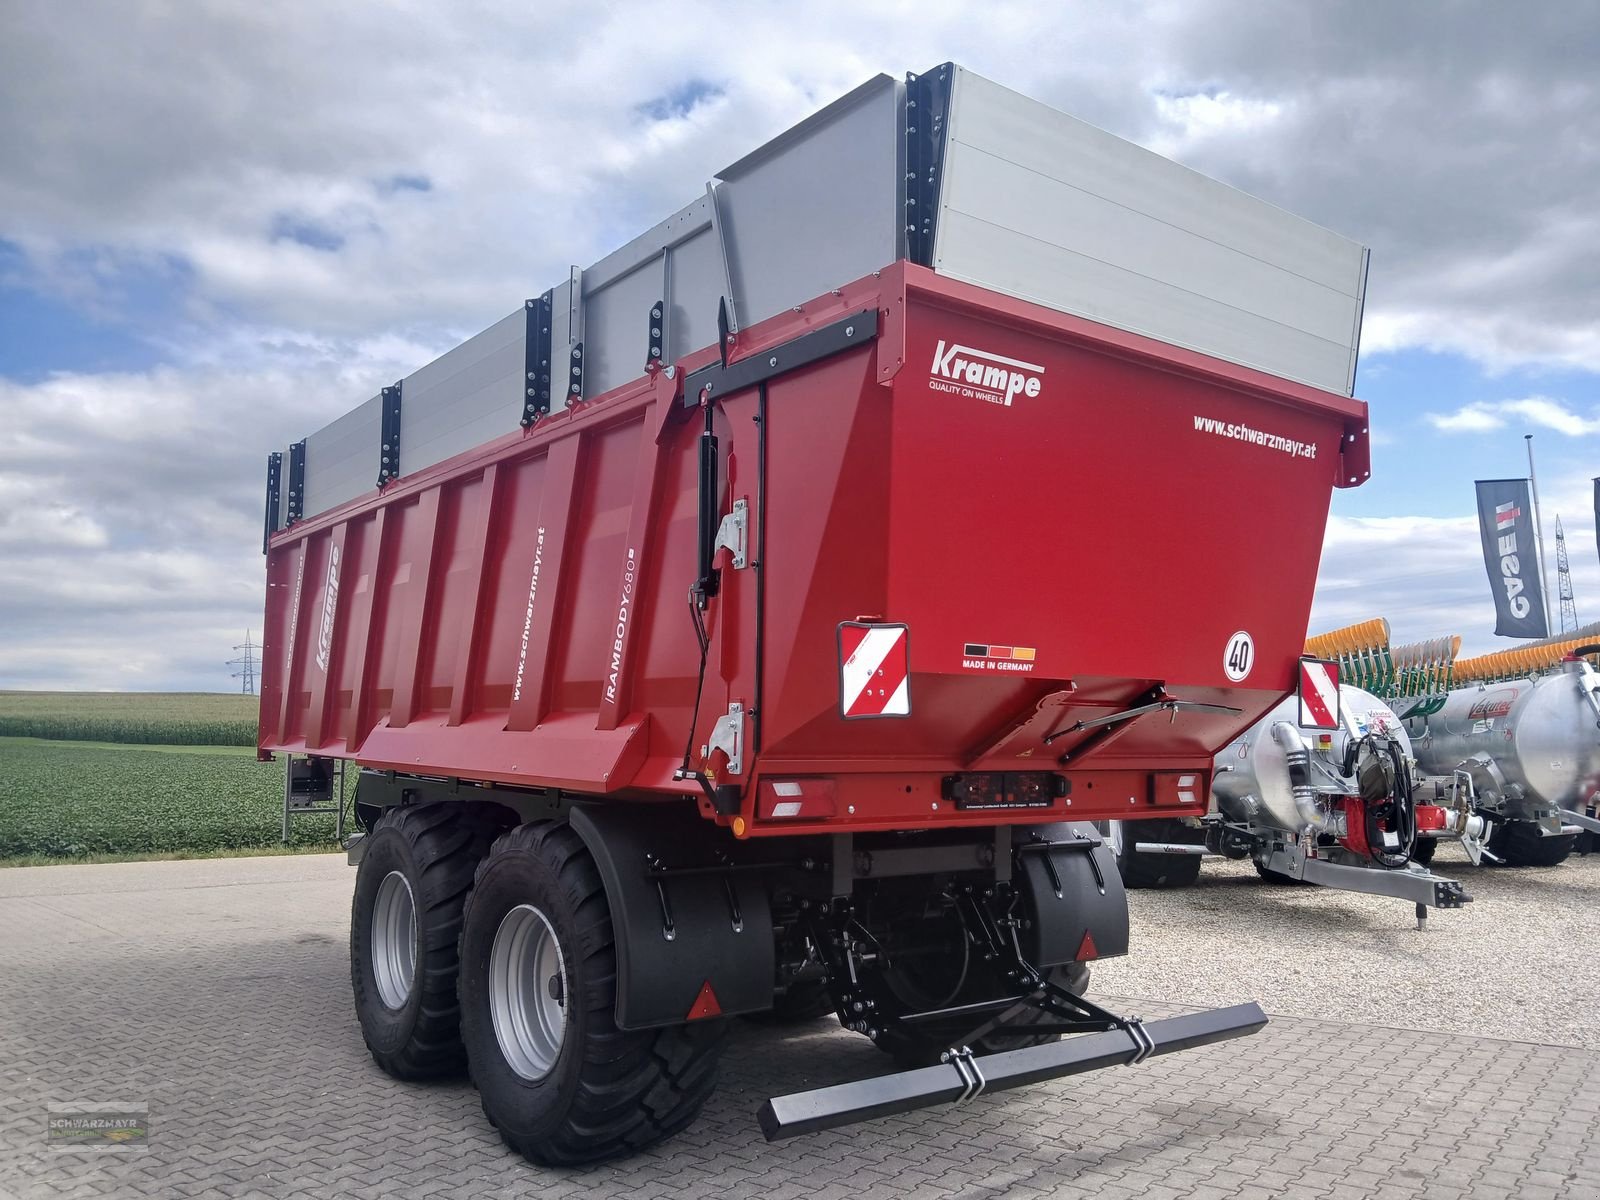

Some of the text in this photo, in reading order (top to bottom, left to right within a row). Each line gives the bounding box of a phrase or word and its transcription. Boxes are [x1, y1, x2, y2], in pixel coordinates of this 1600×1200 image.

[931, 340, 1044, 406] Krampe
[929, 381, 1004, 405] QUALITY ON WHEELS
[1193, 415, 1317, 459] www.schwarzmayr.at
[316, 542, 339, 671] Krampe
[514, 526, 545, 701] www.schwarzmayr.at
[962, 660, 1034, 672] MADE IN GERMANY
[1229, 640, 1249, 672] 40
[1468, 699, 1515, 720] Vakutec
